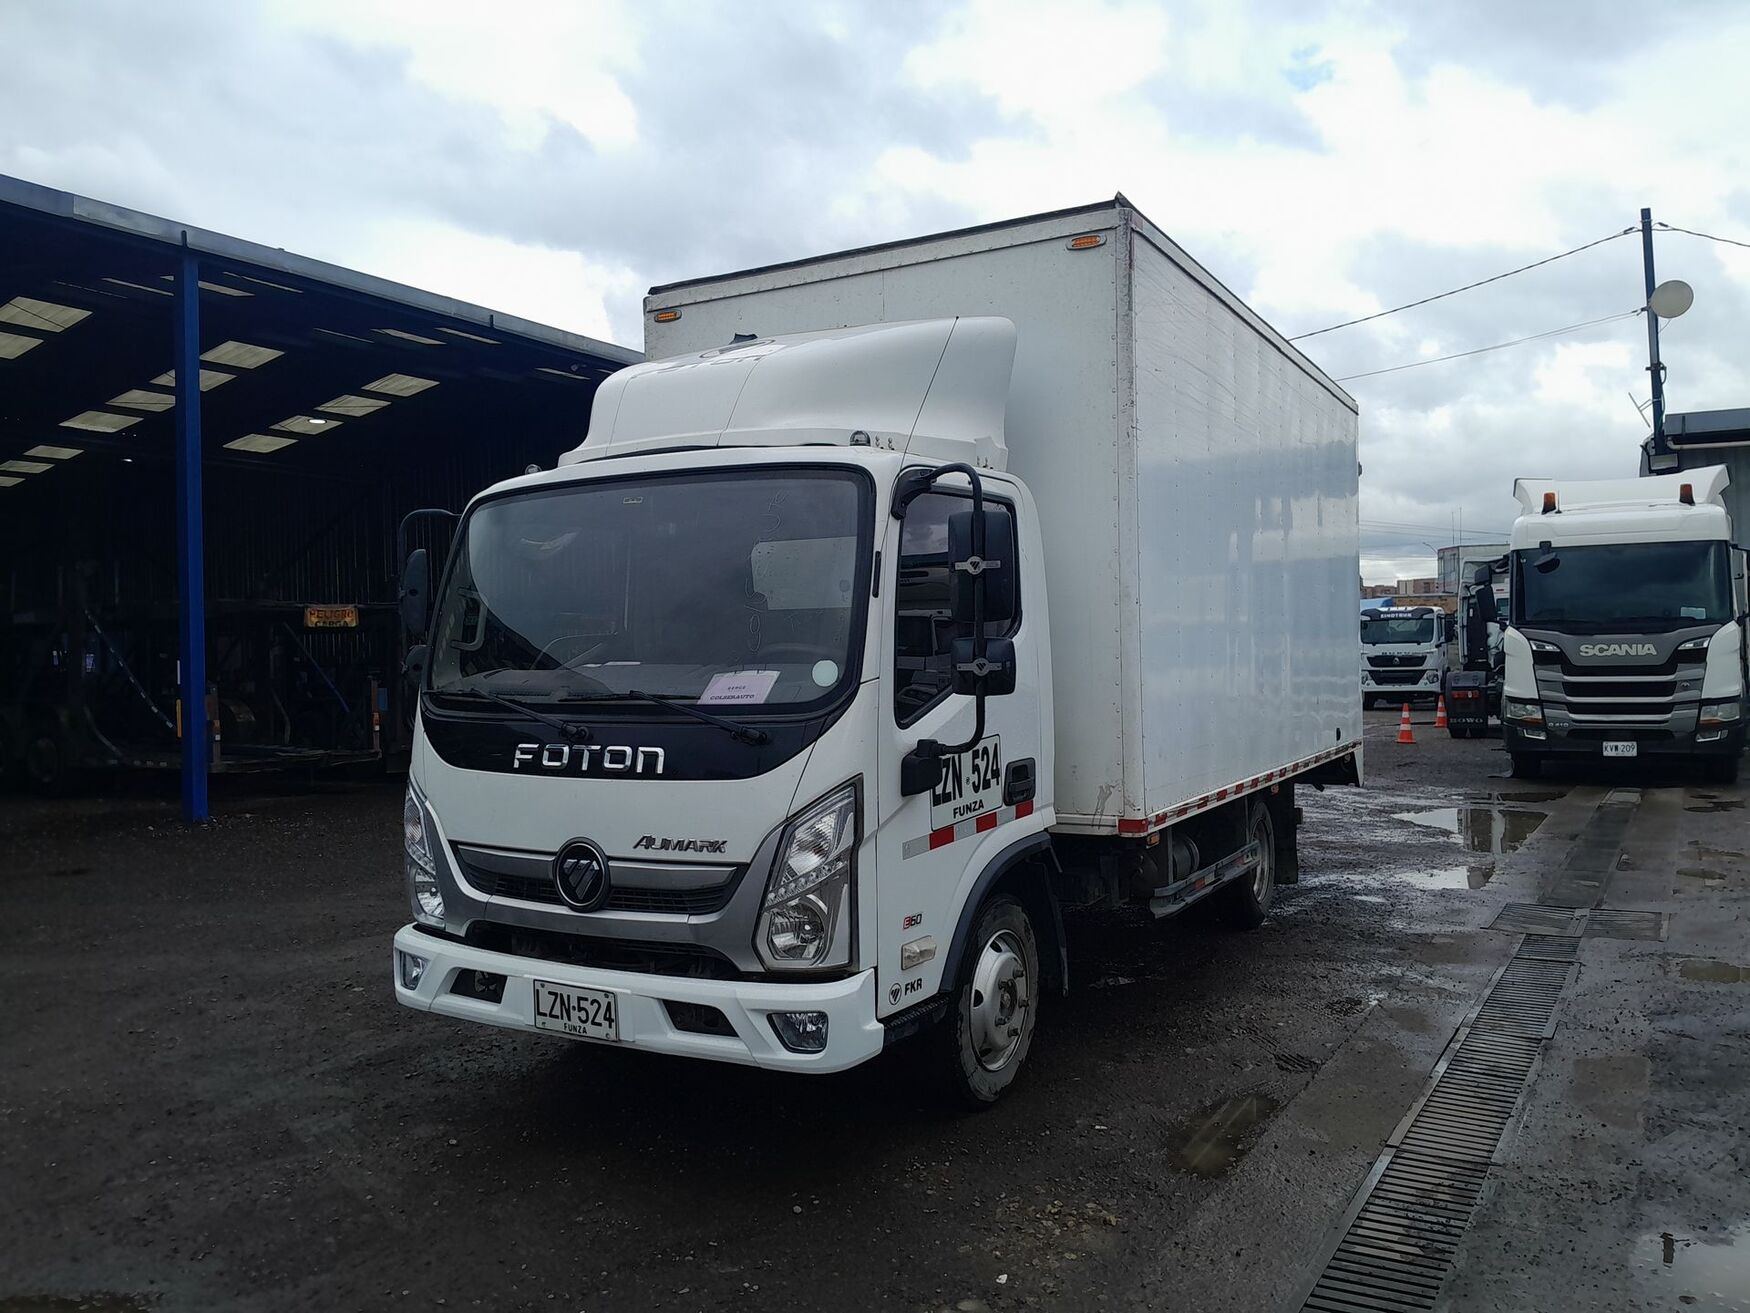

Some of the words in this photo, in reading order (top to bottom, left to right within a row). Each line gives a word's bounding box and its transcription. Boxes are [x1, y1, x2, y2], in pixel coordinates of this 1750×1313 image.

[1579, 643, 1657, 656] SCANIA
[513, 743, 665, 774] FOTON
[971, 743, 1000, 793] 524
[953, 799, 984, 819] FUNZA
[632, 833, 728, 854] AUMARK
[904, 978, 922, 996] FKR
[563, 1022, 587, 1034] FUNZA
